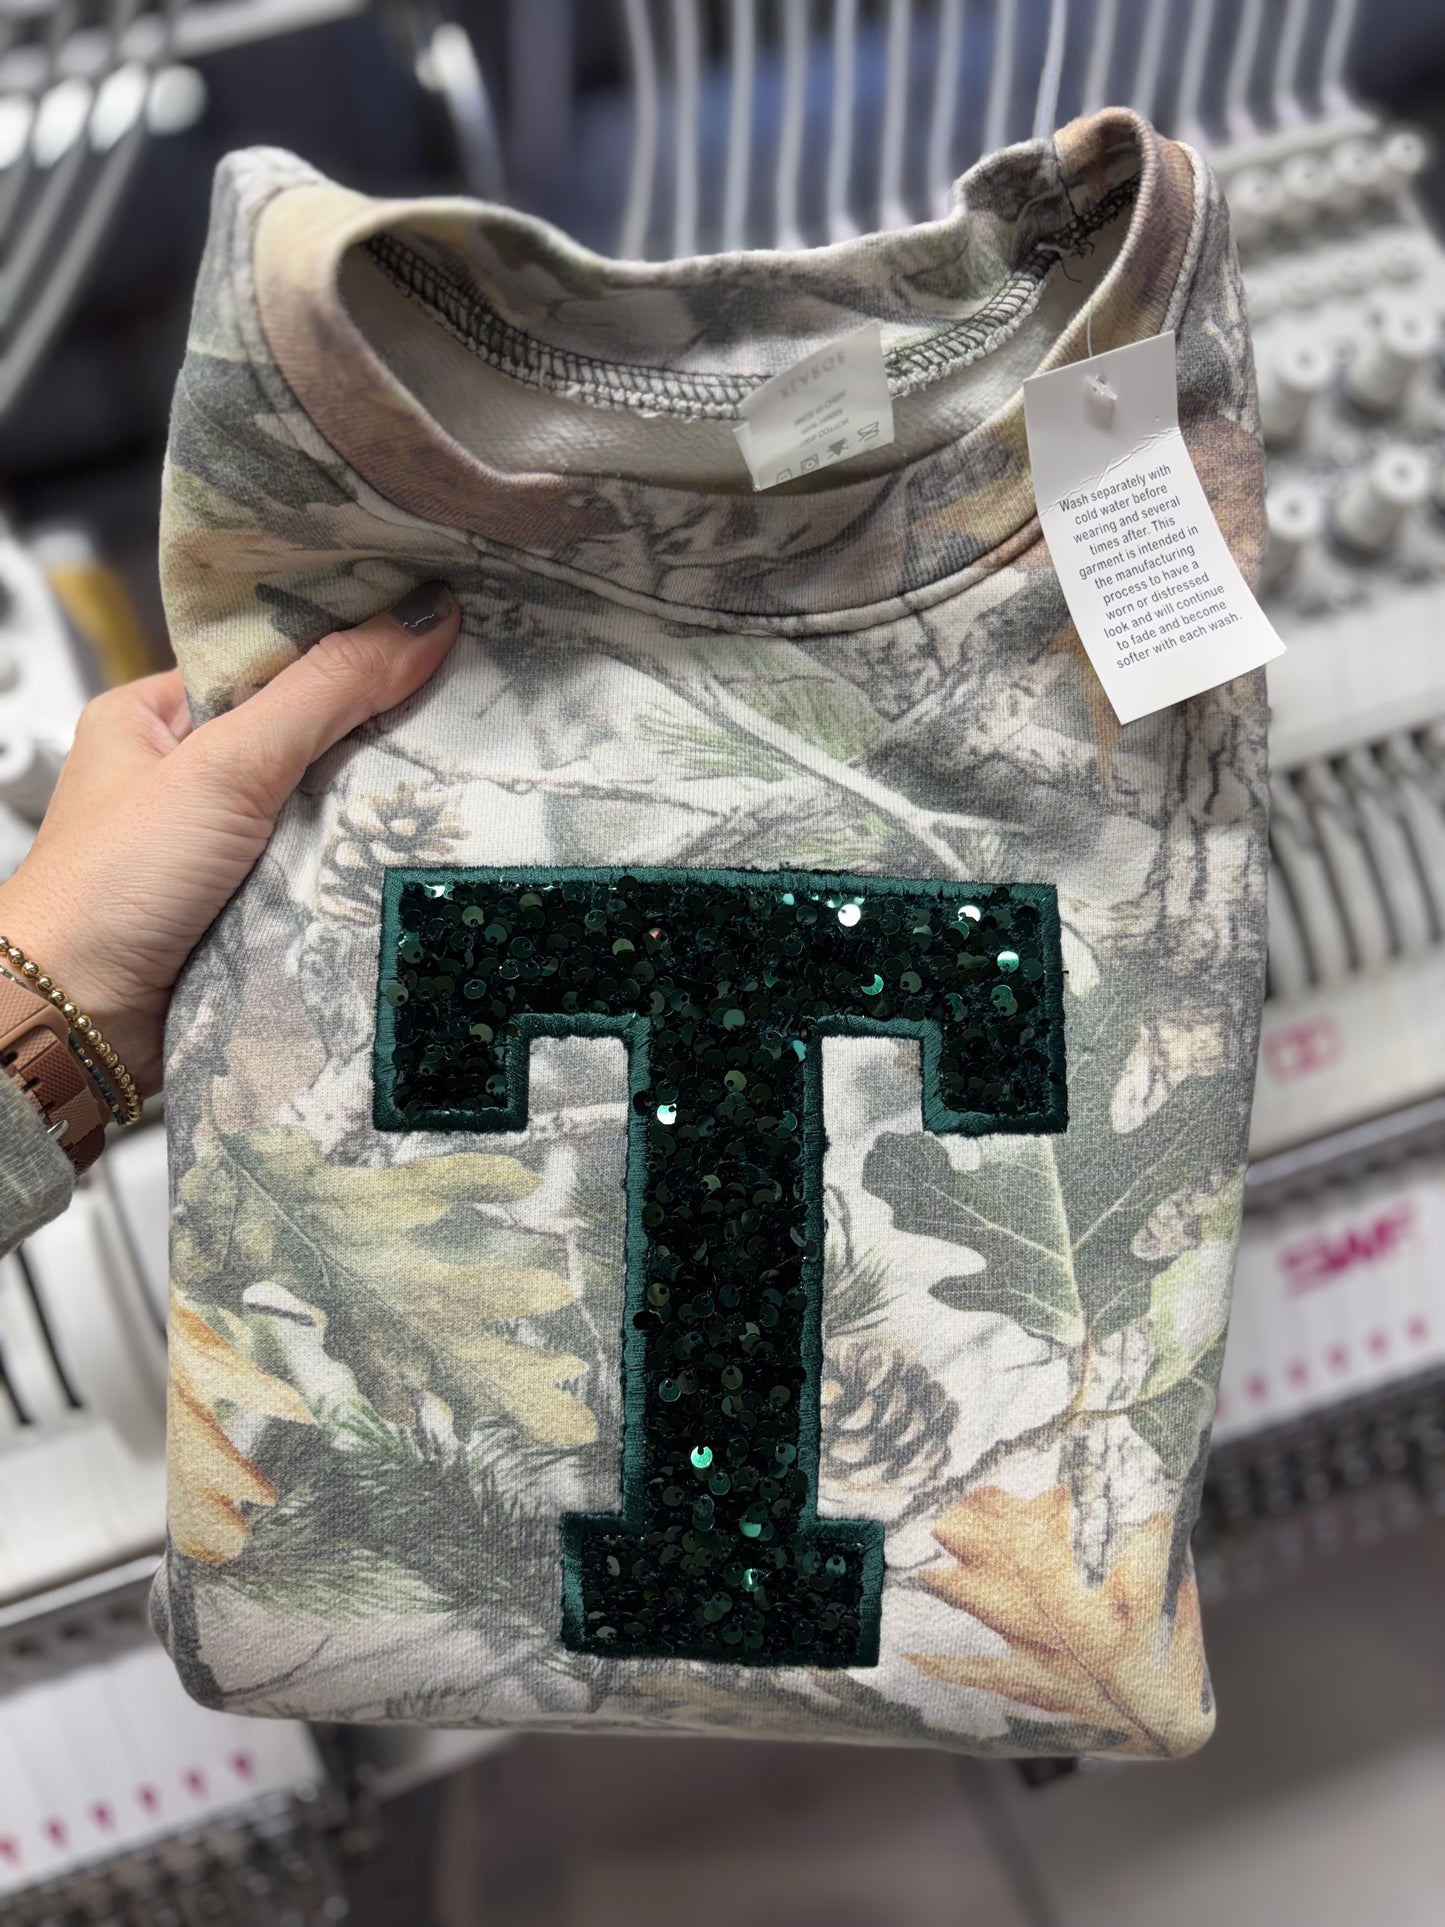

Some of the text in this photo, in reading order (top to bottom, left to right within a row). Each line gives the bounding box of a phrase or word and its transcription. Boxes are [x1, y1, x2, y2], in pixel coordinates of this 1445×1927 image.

[1058, 464, 1171, 513] Wash separately with
[1074, 484, 1168, 525] cold water before
[1073, 495, 1181, 543] wearing and several
[1089, 516, 1176, 556] times after. This
[1078, 525, 1199, 580] garment is intended in
[1094, 545, 1196, 590] the manufacturing
[1102, 560, 1200, 606] process to have a
[1105, 571, 1210, 621] worn or distressed
[1103, 584, 1225, 639] look and will continue
[1116, 601, 1227, 651] to fade and become
[1116, 612, 1243, 669] softer with each wash.
[373, 865, 1069, 1668] T
